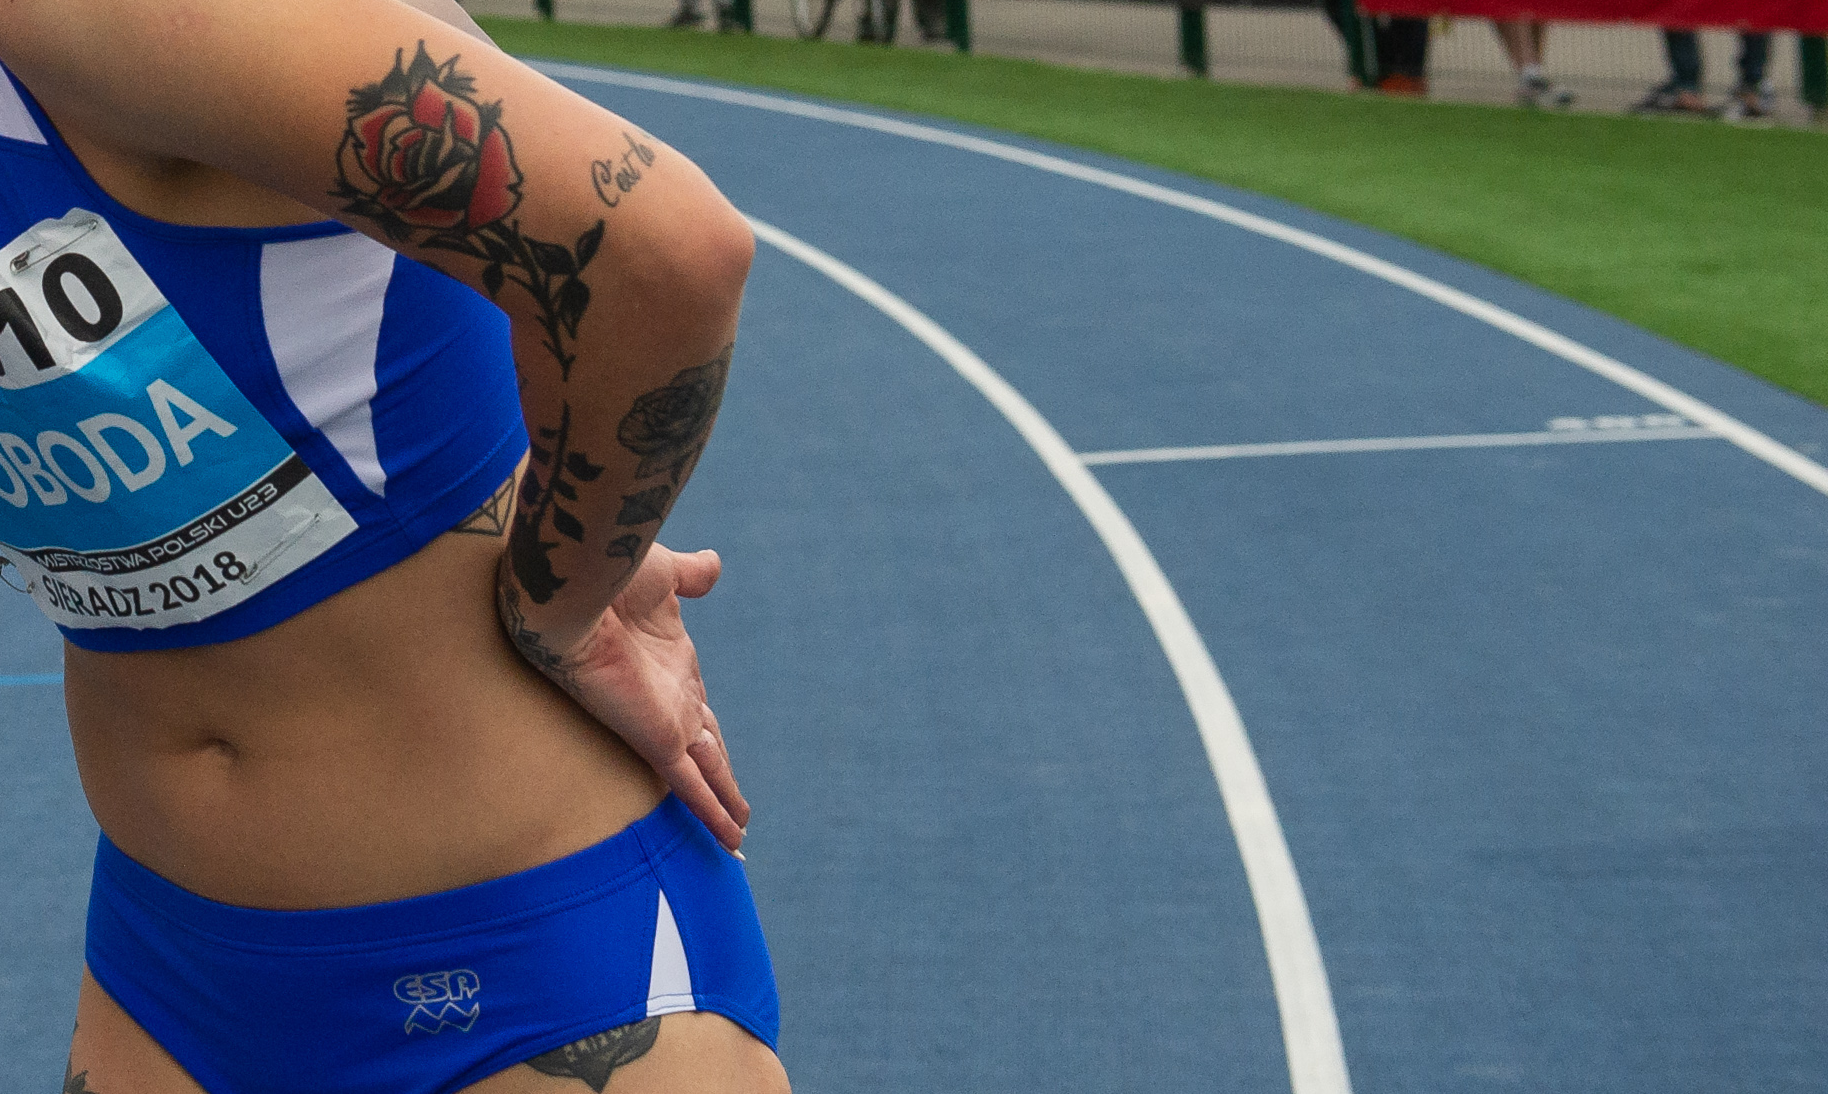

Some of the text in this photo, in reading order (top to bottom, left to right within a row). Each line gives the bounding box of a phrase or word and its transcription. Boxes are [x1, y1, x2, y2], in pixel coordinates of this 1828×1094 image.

[36, 481, 279, 572] MISTRZOSTWA POLSKI U23
[42, 550, 248, 618] SIERADZ 2018
